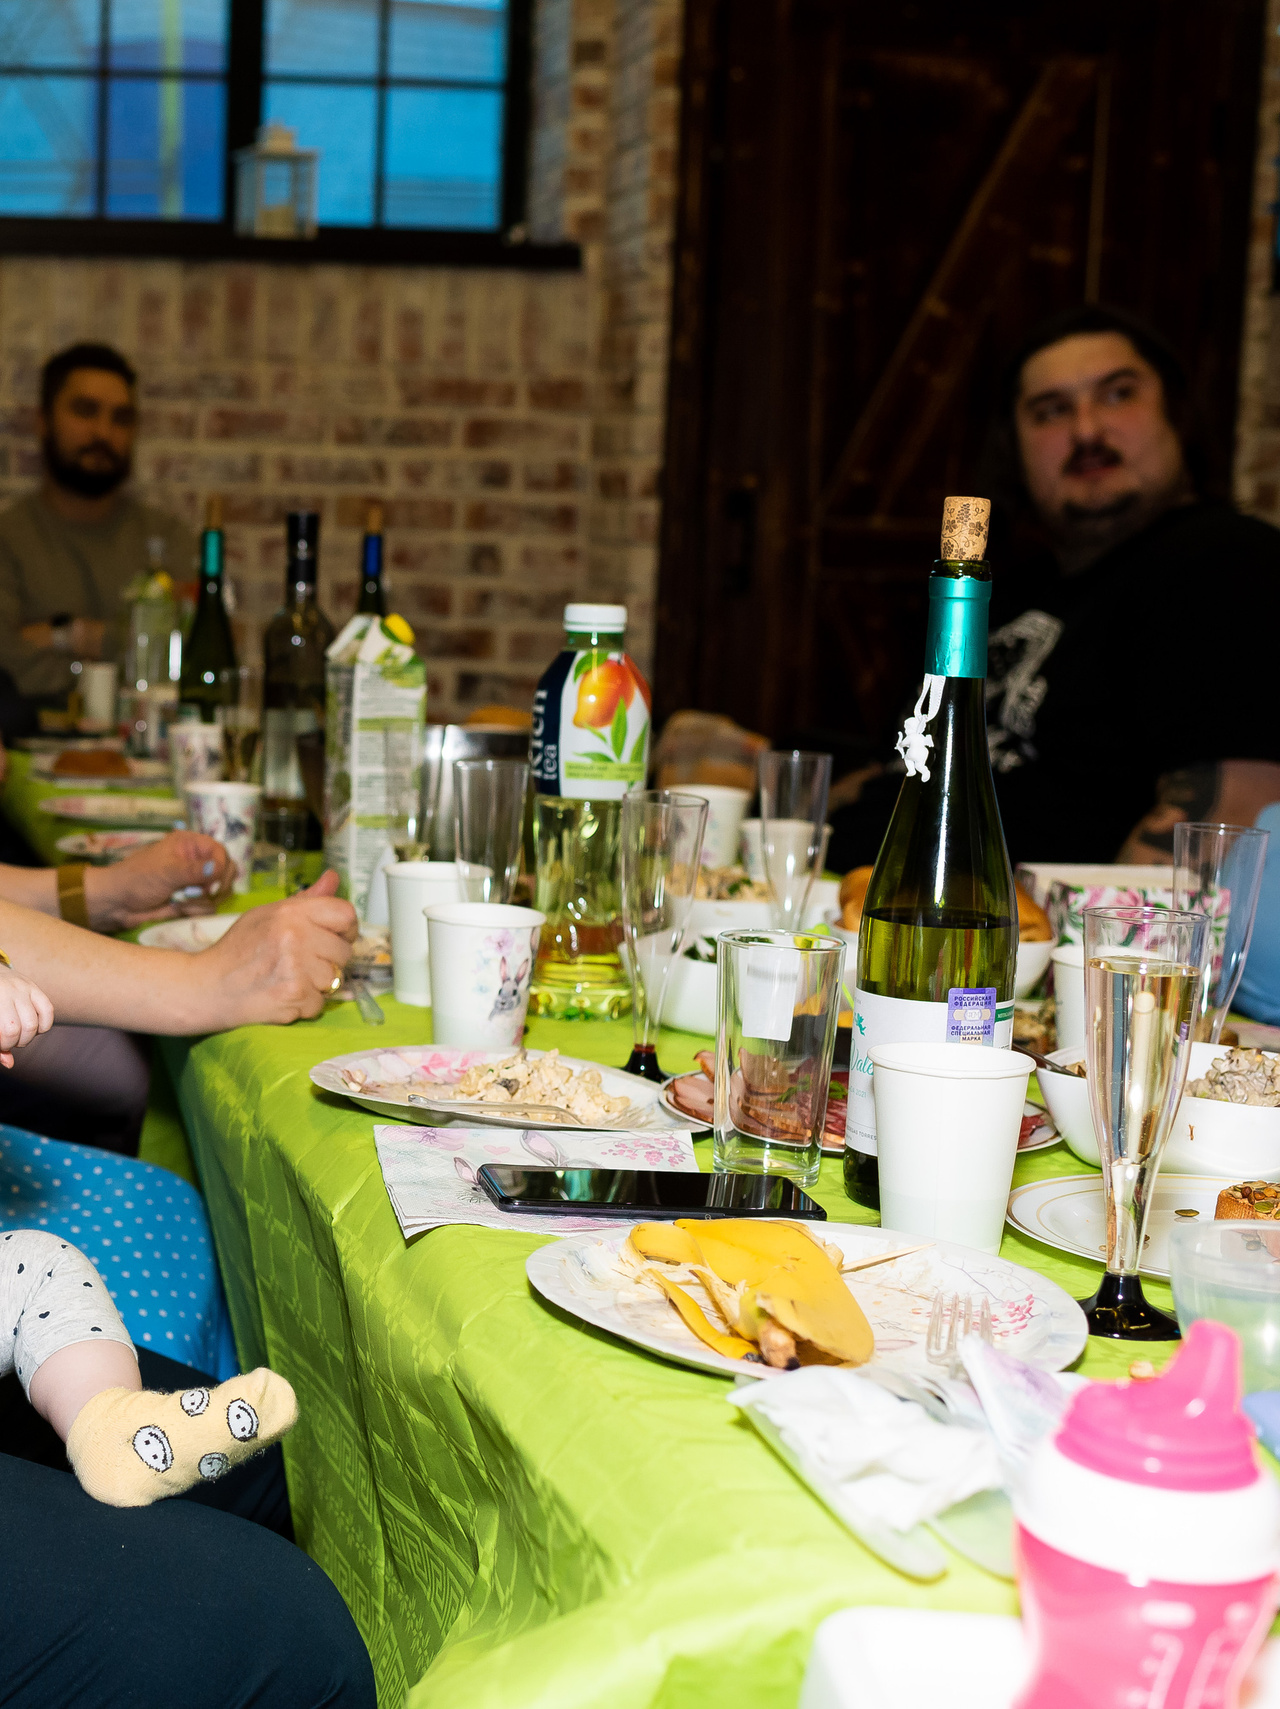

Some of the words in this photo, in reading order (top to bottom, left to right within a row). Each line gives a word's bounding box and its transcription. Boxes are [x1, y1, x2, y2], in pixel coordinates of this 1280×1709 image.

[542, 744, 558, 781] tea
[855, 1089, 867, 1098] 2021
[858, 1130, 877, 1141] TORRES
